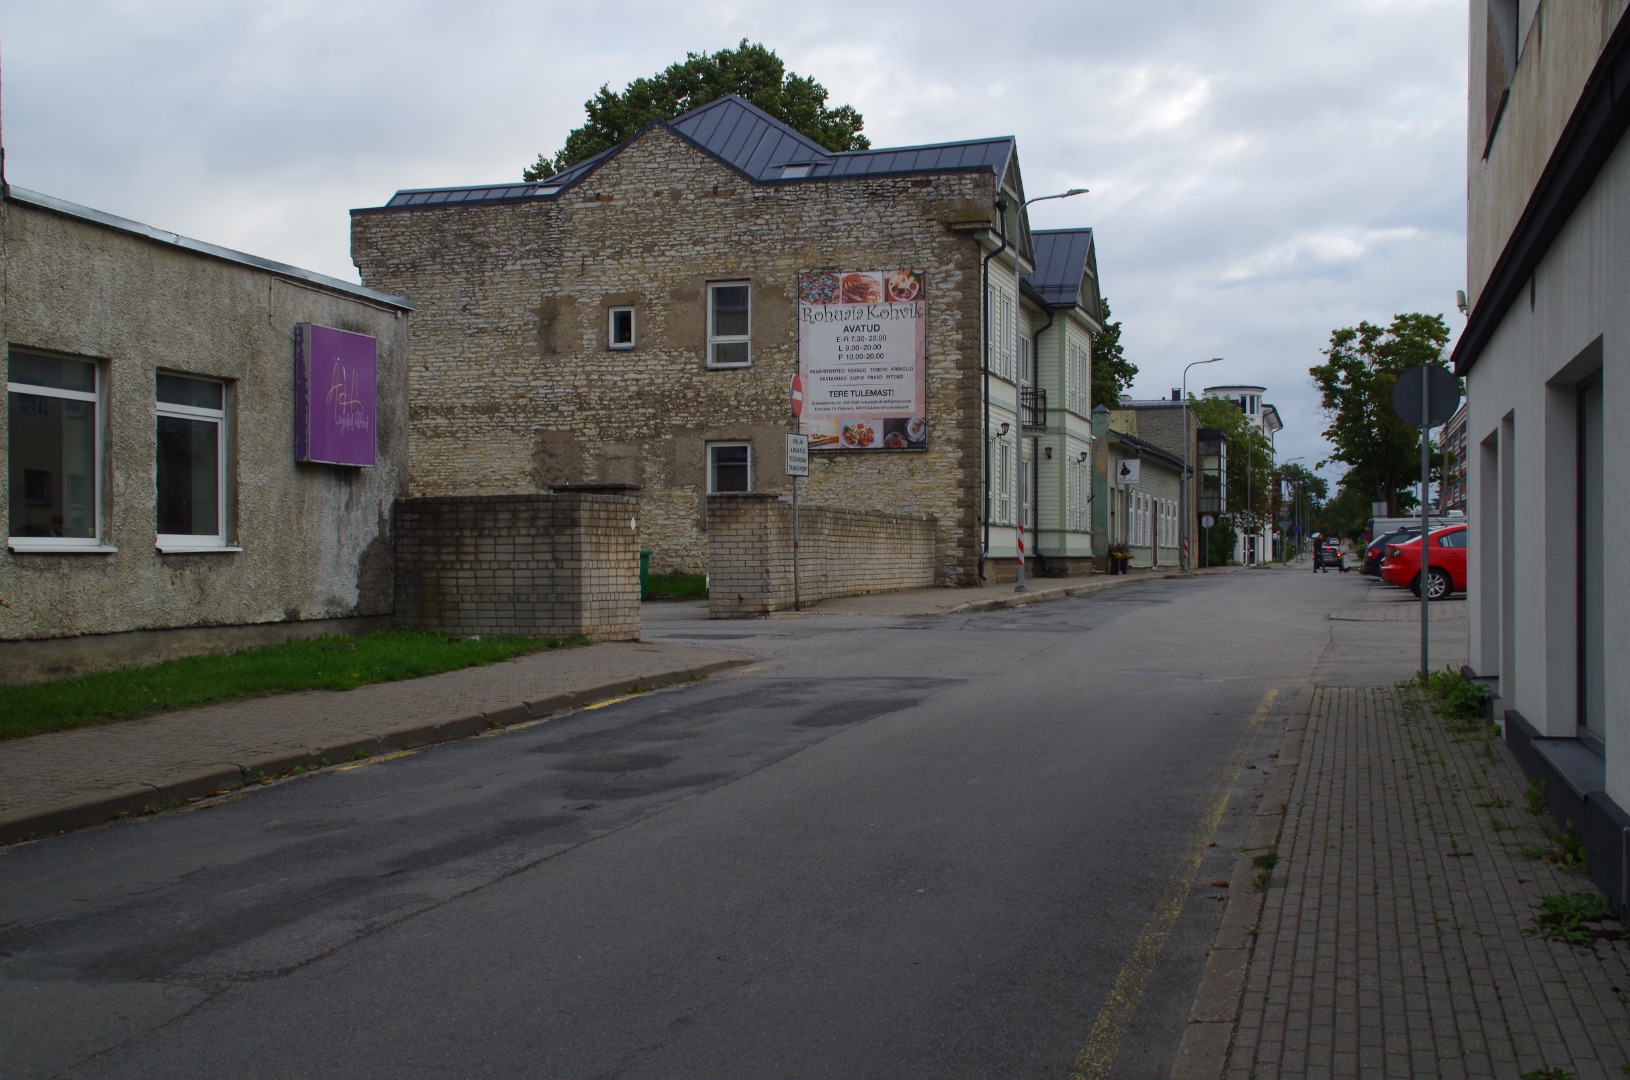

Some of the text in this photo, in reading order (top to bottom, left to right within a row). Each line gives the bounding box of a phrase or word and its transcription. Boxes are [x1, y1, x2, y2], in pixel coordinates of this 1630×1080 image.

[866, 301, 924, 321] Kohvik
[843, 324, 880, 333] AVATUD
[828, 389, 895, 398] TERE TULEMAST!
[788, 464, 808, 472] TRANSPORT
